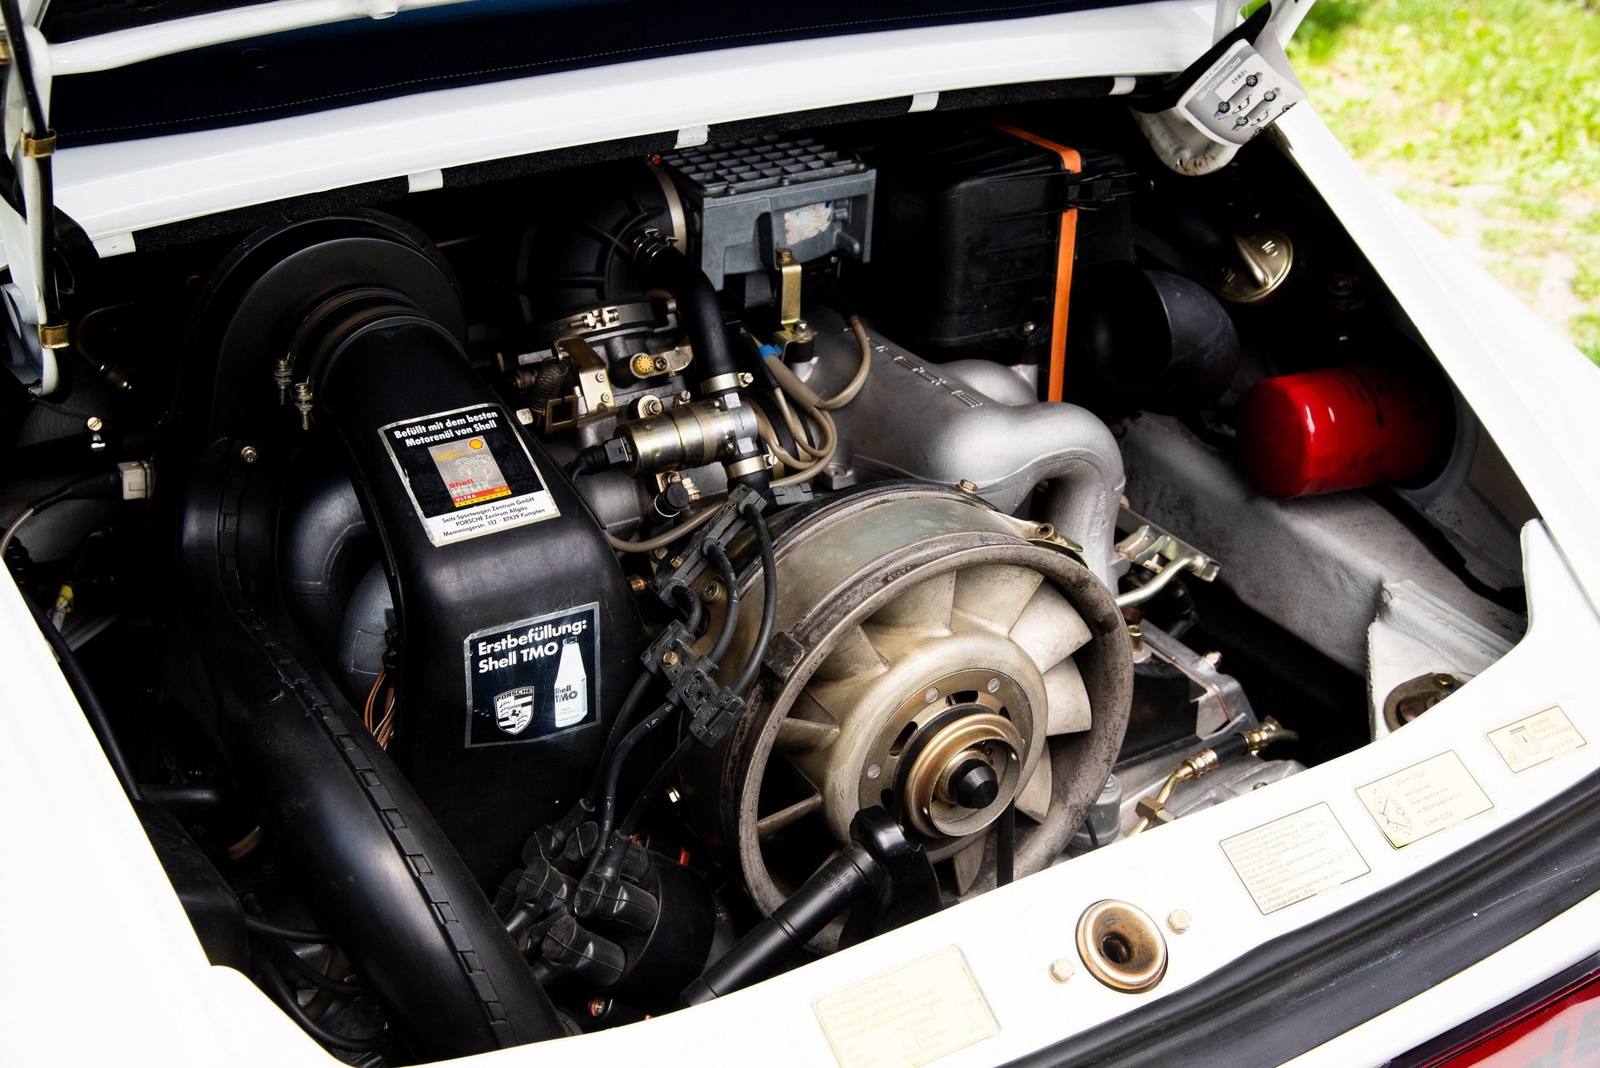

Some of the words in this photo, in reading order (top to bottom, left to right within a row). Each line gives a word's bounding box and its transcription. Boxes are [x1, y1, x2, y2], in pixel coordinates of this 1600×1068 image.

[394, 426, 426, 439] Befüllt
[428, 421, 444, 432] mit
[445, 418, 466, 428] dem
[466, 411, 498, 423] besten
[405, 429, 454, 447] Motorenöl
[455, 427, 473, 436] von
[473, 420, 497, 432] Shell
[448, 479, 474, 488] Shell
[455, 494, 476, 502] ULTRA
[456, 508, 491, 520] Sportwagen
[491, 502, 515, 512] Zentrum
[516, 497, 535, 505] GmbH
[456, 516, 484, 526] PORSCHE
[485, 511, 508, 520] Zentrum
[478, 620, 587, 656] Erstbefüllung:
[479, 651, 517, 673] Shell
[520, 641, 559, 662] TMO
[496, 688, 532, 701] PORSCHE
[554, 684, 572, 695] Shell
[555, 690, 578, 703] TMO
